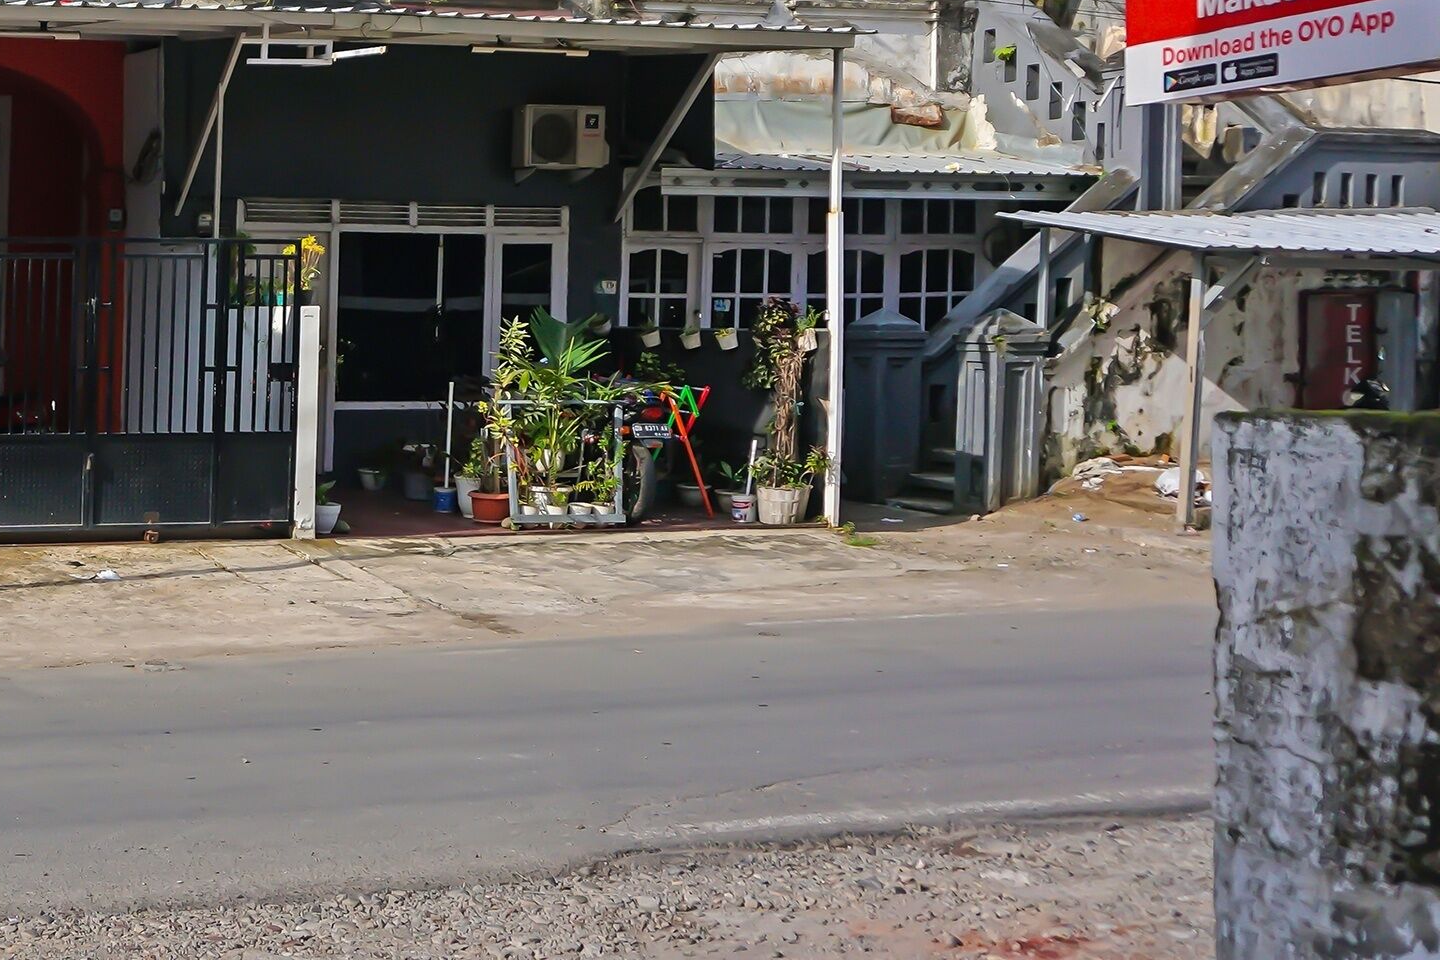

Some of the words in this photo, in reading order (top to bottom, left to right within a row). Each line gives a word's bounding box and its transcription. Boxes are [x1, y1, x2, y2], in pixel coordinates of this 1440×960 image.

[1162, 31, 1256, 67] Download
[1260, 24, 1293, 50] the
[1298, 15, 1344, 42] OYO
[1349, 10, 1395, 37] App
